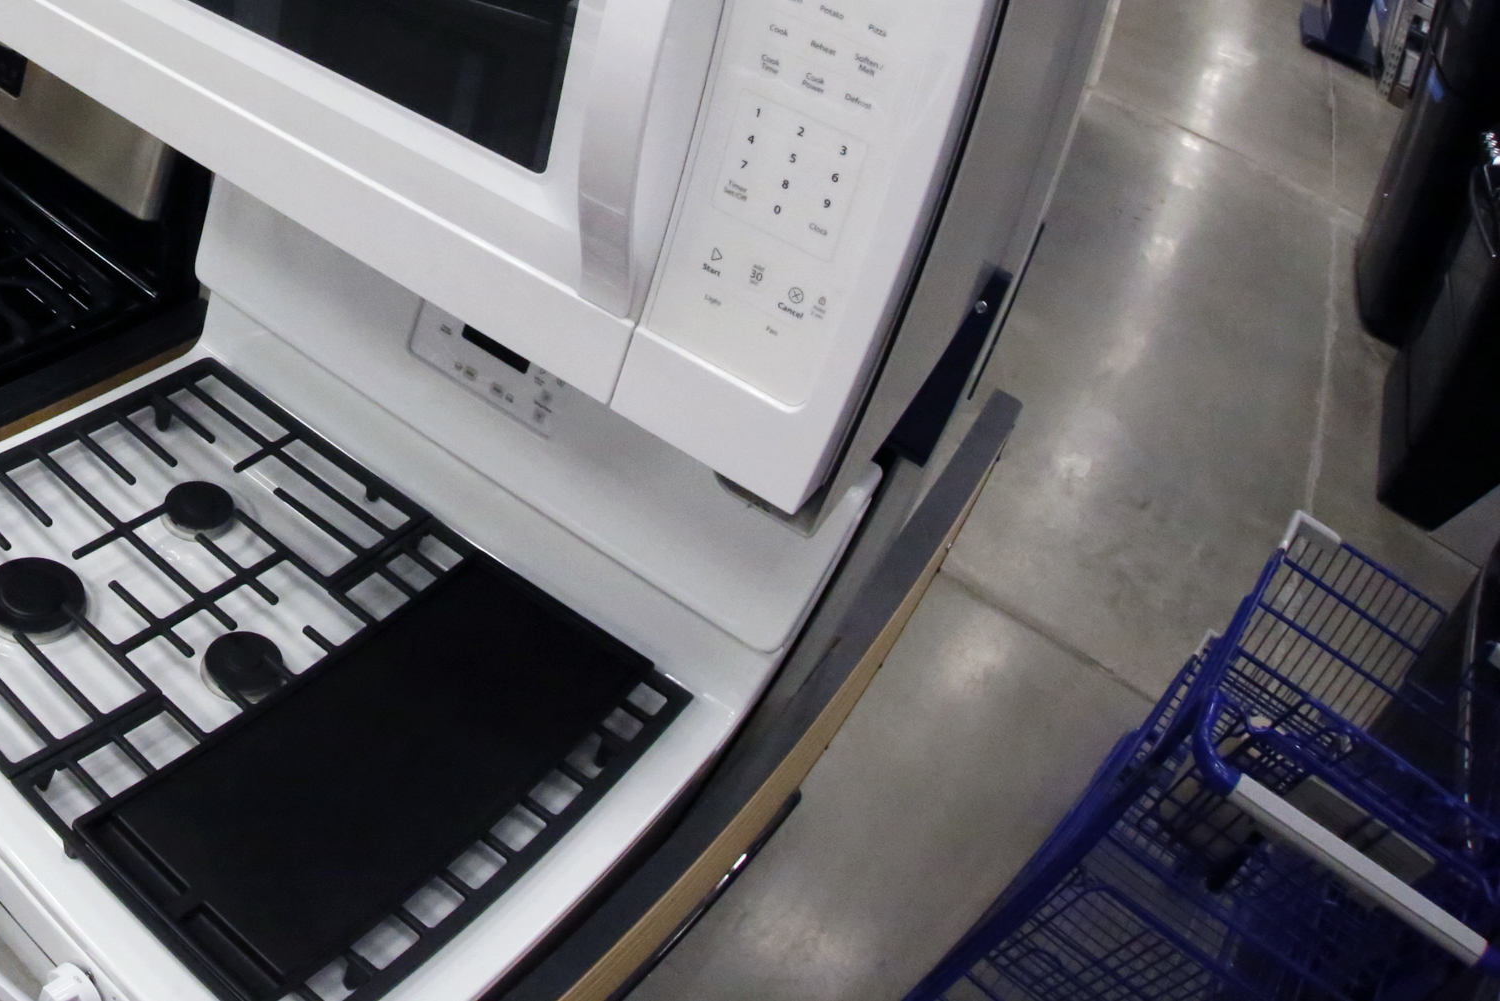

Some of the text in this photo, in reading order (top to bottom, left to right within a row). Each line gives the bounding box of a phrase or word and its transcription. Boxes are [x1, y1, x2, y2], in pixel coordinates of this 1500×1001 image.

[819, 5, 845, 20] Potato
[769, 24, 789, 38] Cook
[868, 24, 887, 38] Pizza
[810, 40, 836, 57] Reheat
[761, 53, 780, 67] Cook
[854, 53, 879, 69] Soften
[761, 62, 779, 75] Time
[858, 64, 875, 77] Melt
[805, 72, 825, 85] Cook
[802, 80, 825, 94] Power
[844, 93, 872, 110] Defrost
[755, 108, 761, 118] 1
[797, 126, 805, 138] 2
[747, 134, 755, 144] 4
[840, 145, 847, 156] 3
[741, 160, 748, 169] 7
[789, 153, 797, 163] 5
[831, 172, 839, 183] 6
[728, 179, 747, 193] Timer
[781, 179, 790, 190] 8
[773, 204, 781, 215] 0
[823, 198, 831, 209] 9
[808, 222, 828, 237] Clock
[702, 262, 721, 277] Start
[750, 269, 763, 282] 30
[704, 293, 722, 307] Light
[777, 301, 804, 319] Cancel
[765, 325, 778, 337] Fan
